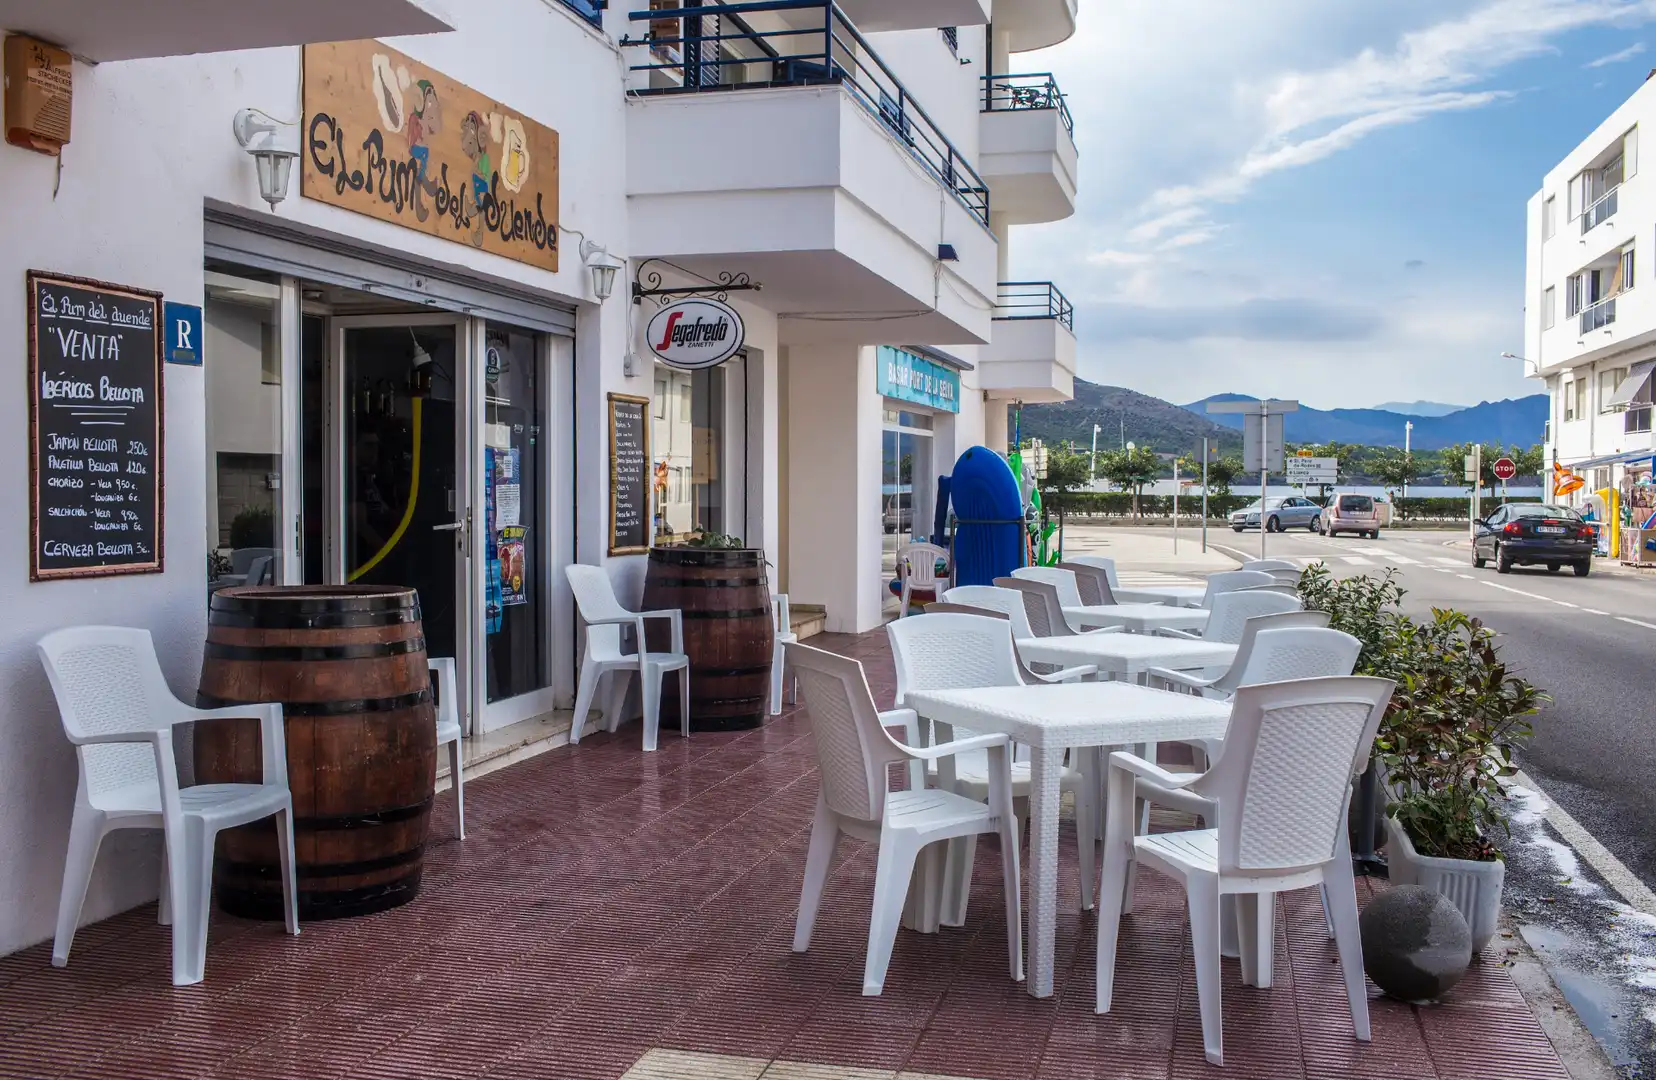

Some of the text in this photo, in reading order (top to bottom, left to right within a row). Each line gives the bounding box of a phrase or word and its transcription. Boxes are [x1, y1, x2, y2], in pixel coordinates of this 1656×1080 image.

[60, 296, 85, 316] Pum
[88, 301, 107, 319] del
[176, 319, 193, 349] R
[656, 311, 728, 350] Segafredo
[888, 362, 908, 386] BASAR
[910, 369, 923, 390] PORT
[83, 437, 118, 452] BELLOTA
[48, 476, 84, 488] CHORIZO
[44, 540, 94, 557] CERVEZA
[96, 541, 134, 555] BELLOTA
